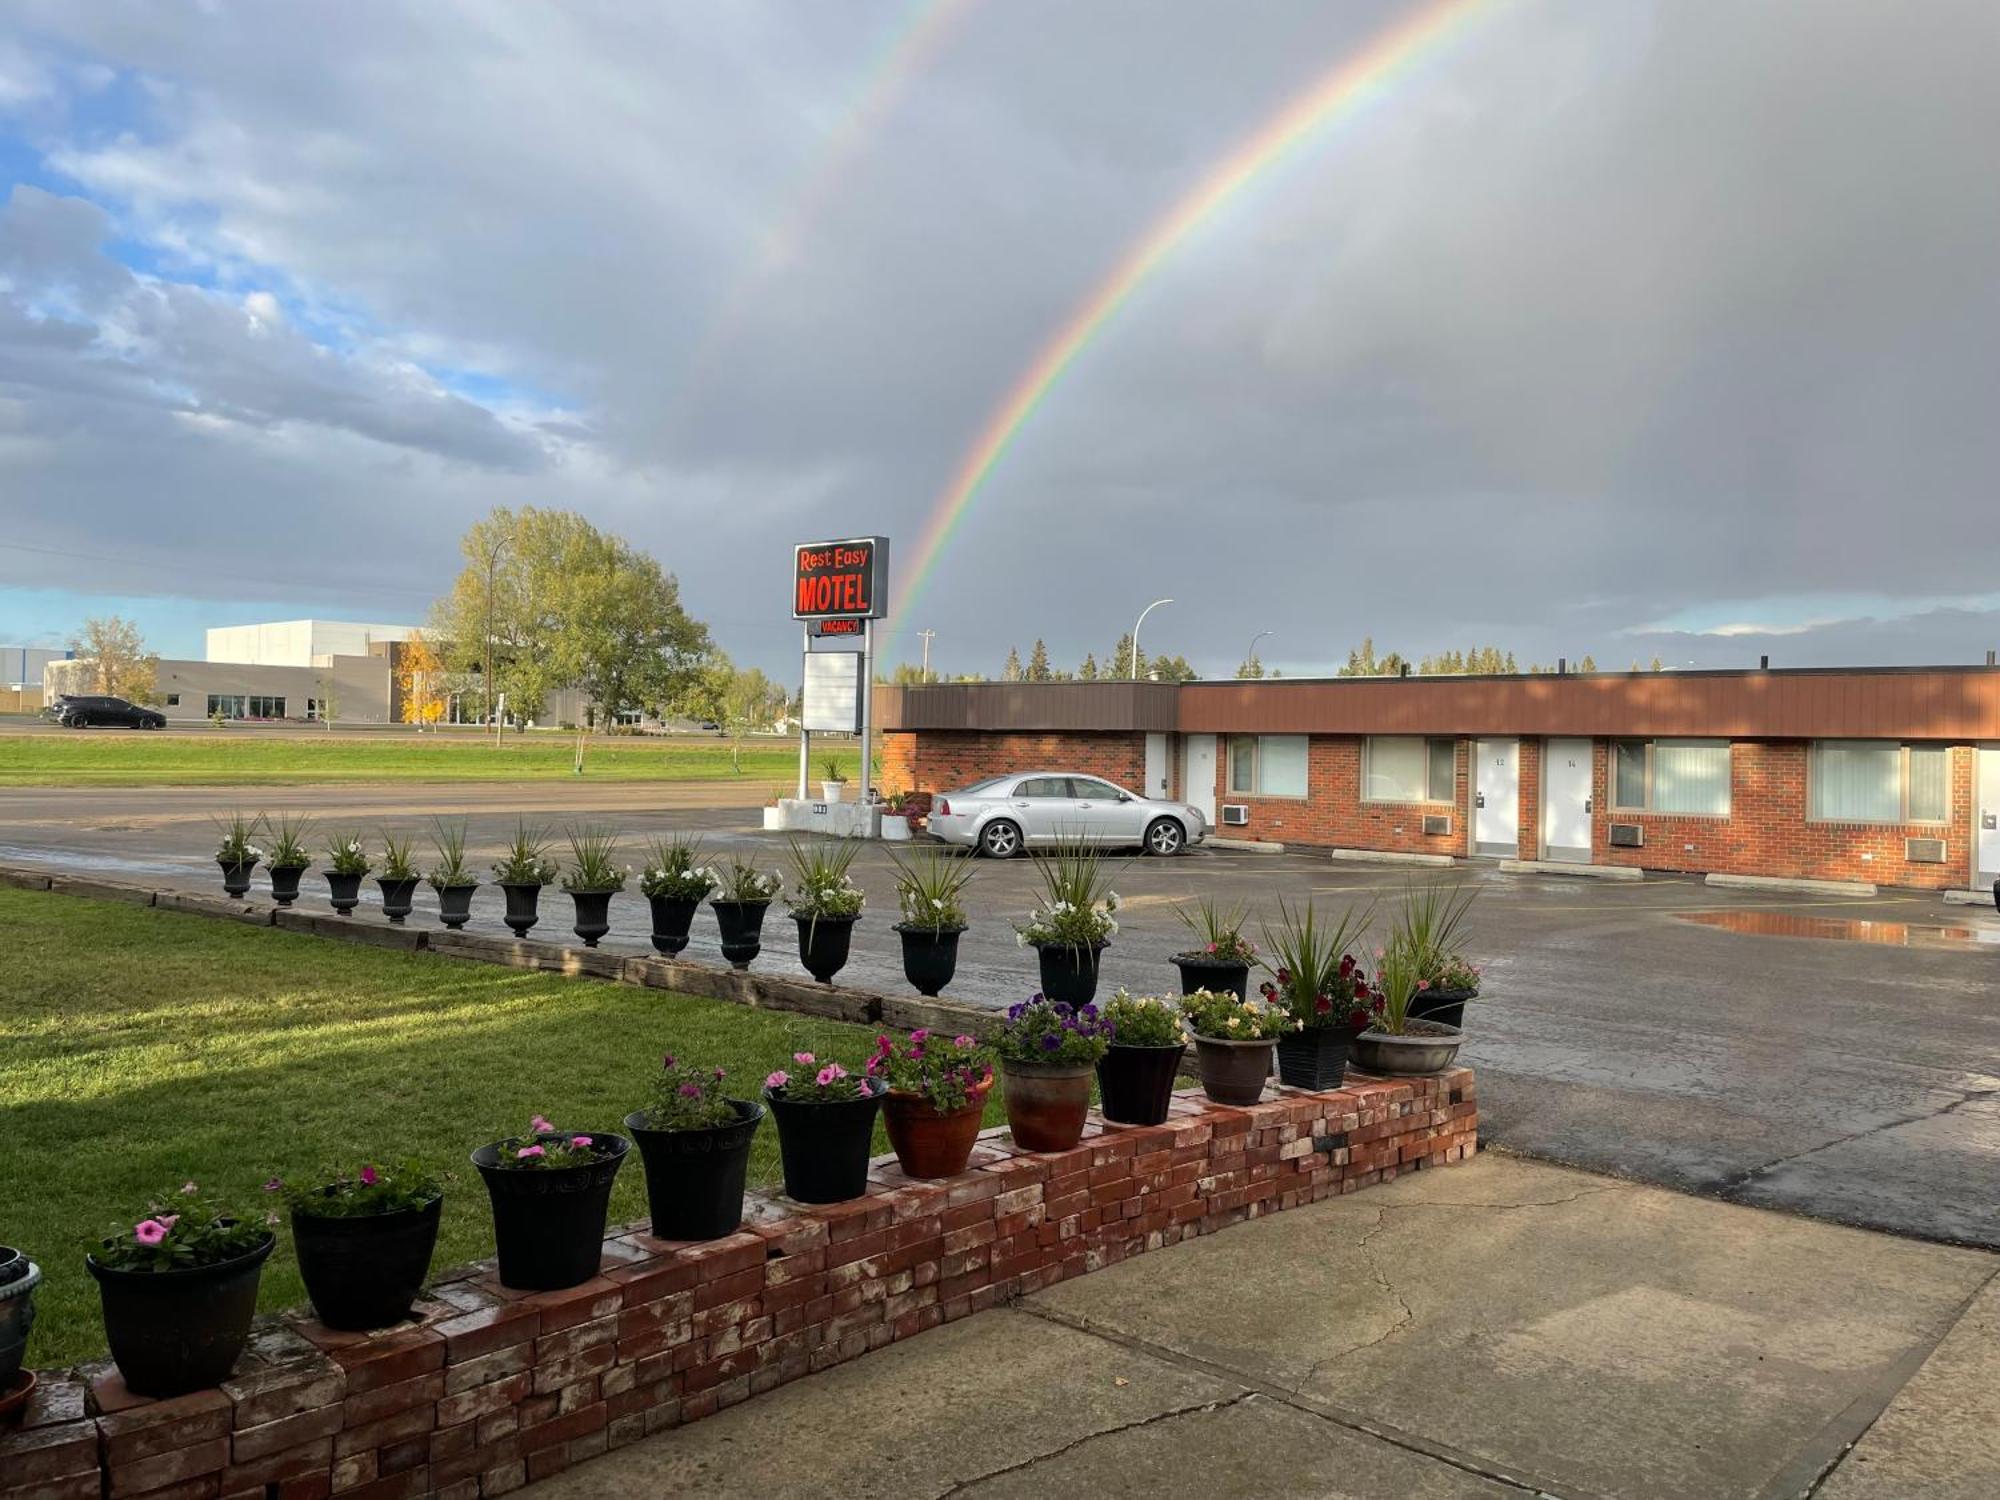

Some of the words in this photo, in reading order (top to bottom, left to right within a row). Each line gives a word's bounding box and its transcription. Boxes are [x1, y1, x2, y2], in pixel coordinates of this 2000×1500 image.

[801, 550, 832, 572] Rest
[835, 547, 868, 569] Easy
[798, 574, 868, 612] MOTEL
[822, 621, 857, 633] VACANCY
